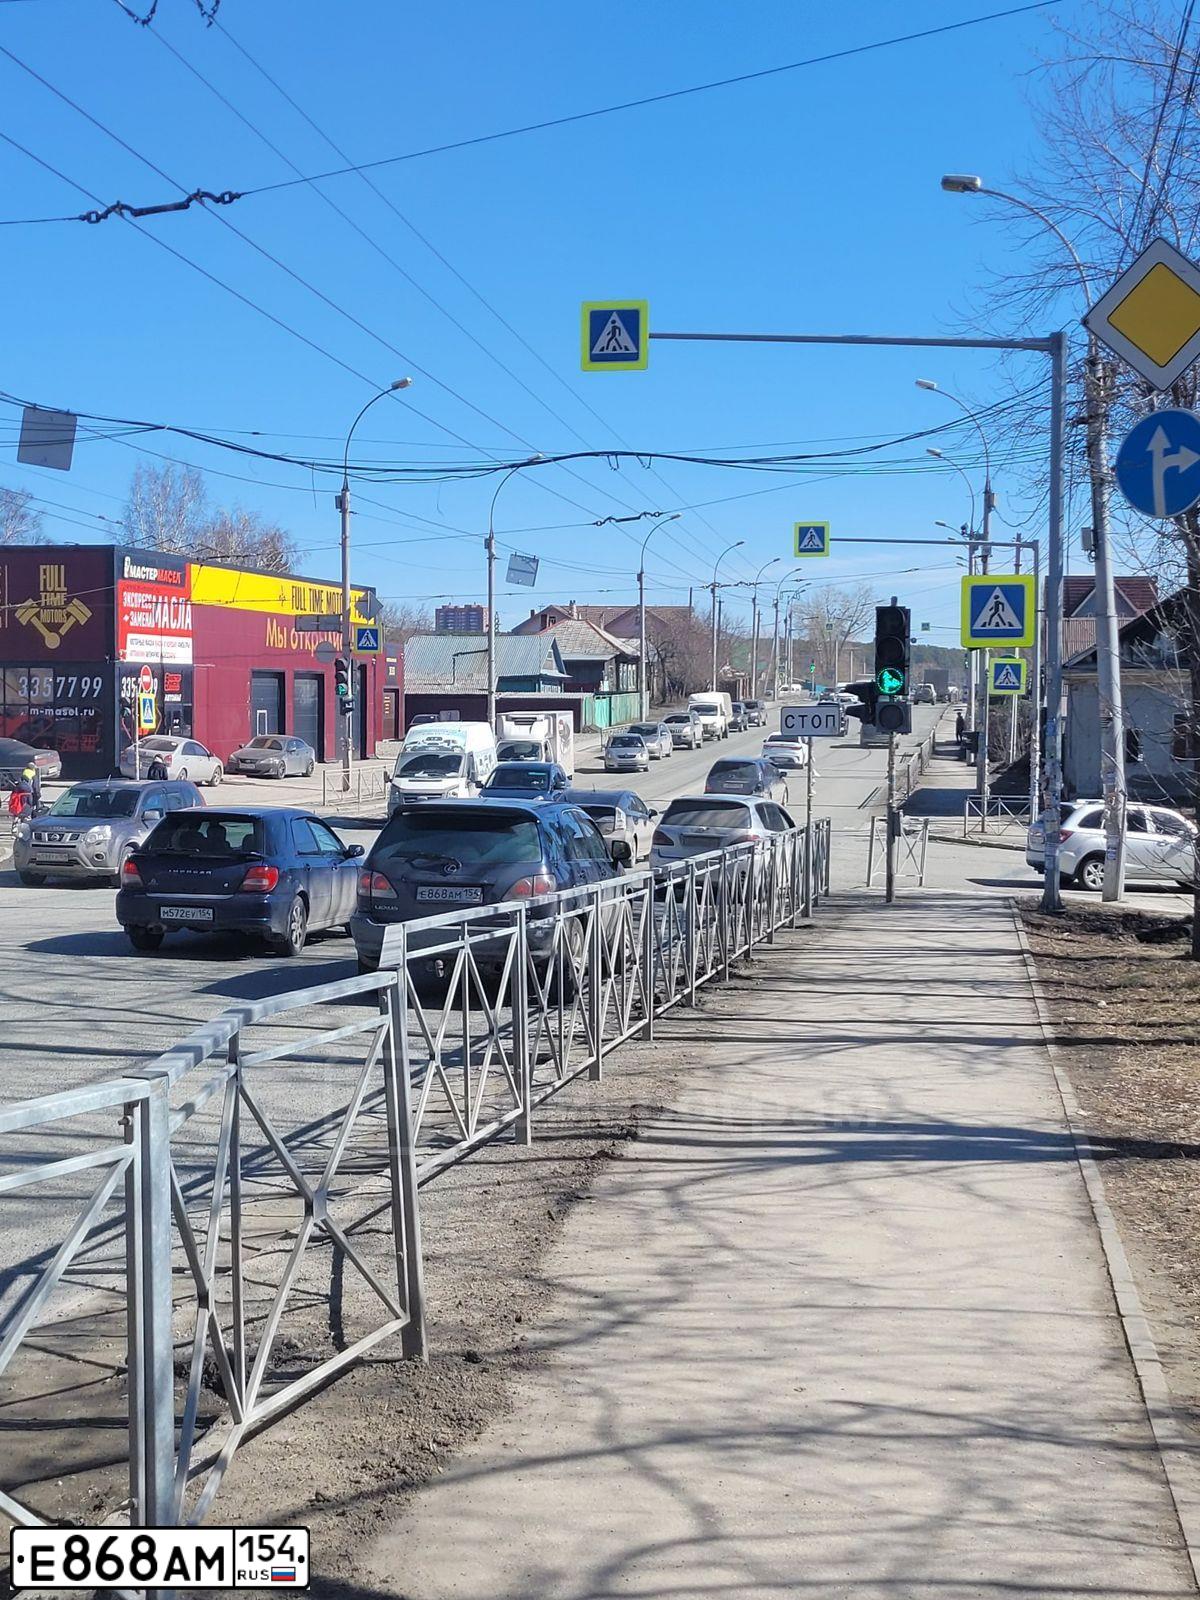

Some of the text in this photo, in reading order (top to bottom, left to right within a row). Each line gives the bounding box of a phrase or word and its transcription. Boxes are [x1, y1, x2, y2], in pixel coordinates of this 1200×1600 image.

[40, 565, 67, 591] FULL
[40, 592, 67, 606] TIME
[291, 586, 306, 611] FULL
[309, 588, 324, 613] TIME
[40, 608, 67, 624] MOTORS
[153, 594, 192, 631] МАСЛА
[266, 617, 287, 649] Мы
[784, 714, 836, 729] СТОП
